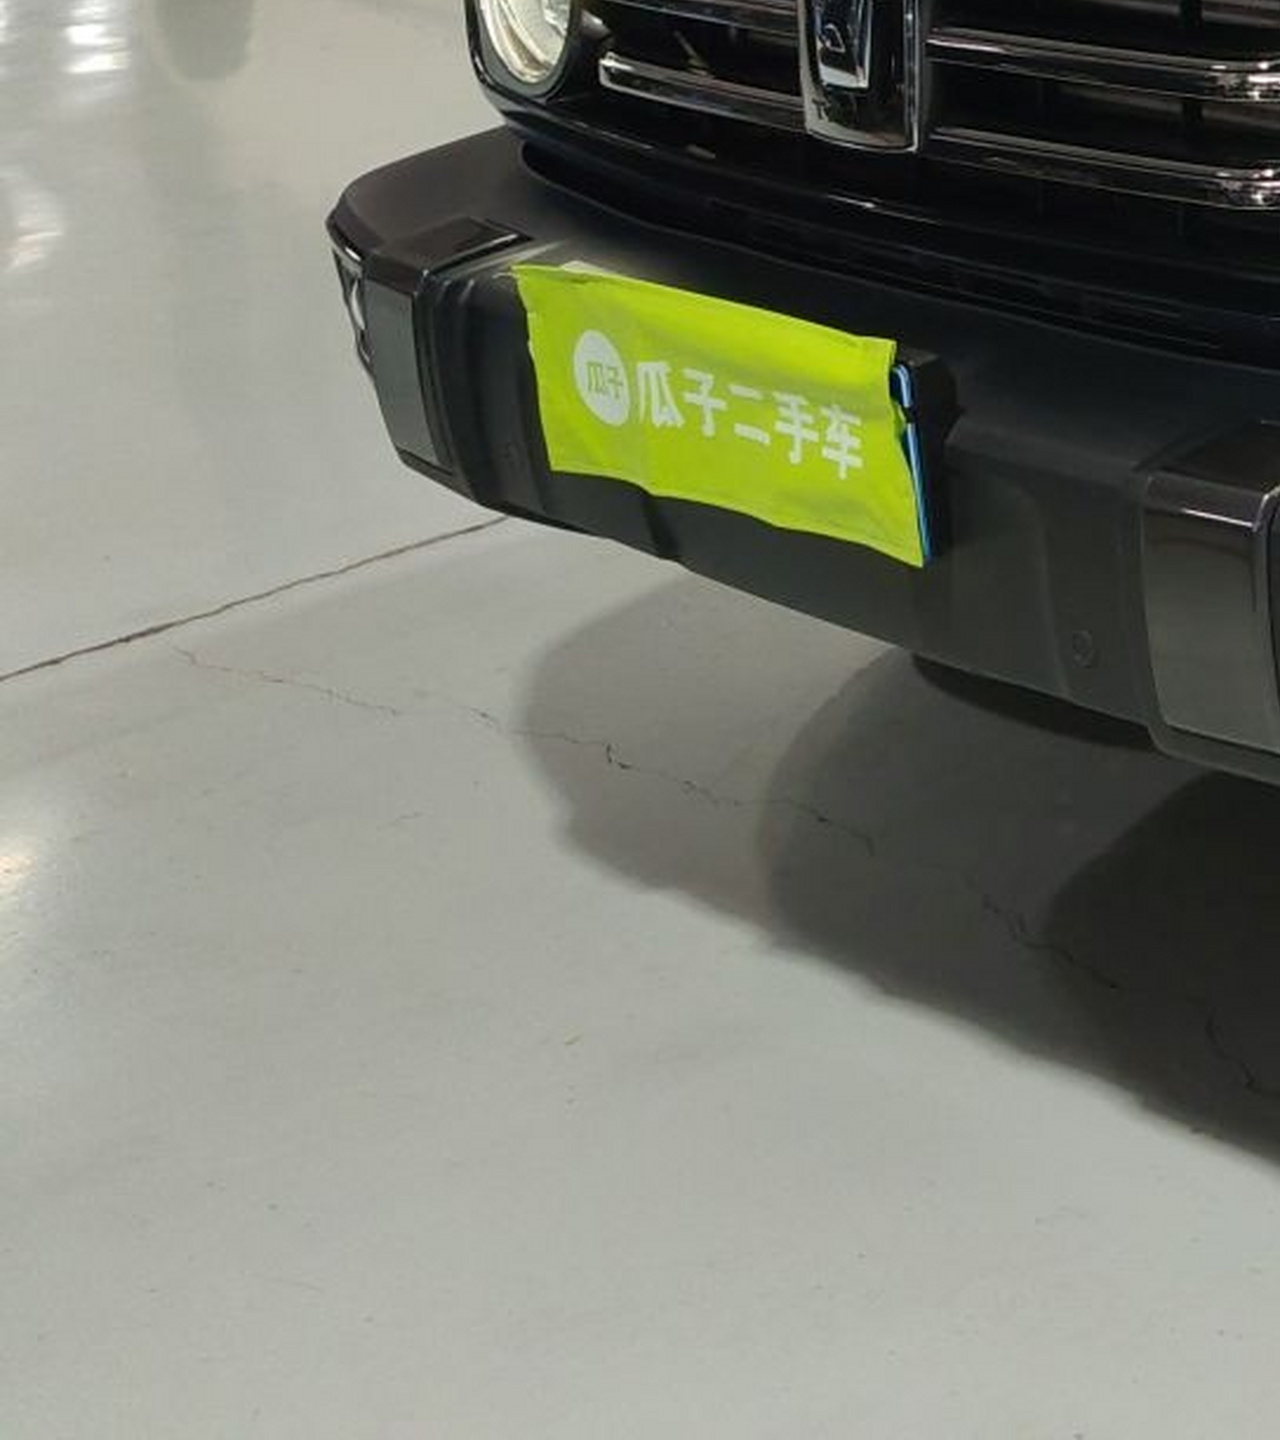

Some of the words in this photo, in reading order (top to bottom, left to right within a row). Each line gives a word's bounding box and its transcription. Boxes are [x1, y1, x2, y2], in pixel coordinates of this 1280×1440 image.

[587, 361, 625, 400] 瓜子
[635, 360, 865, 481] 瓜子二手车
